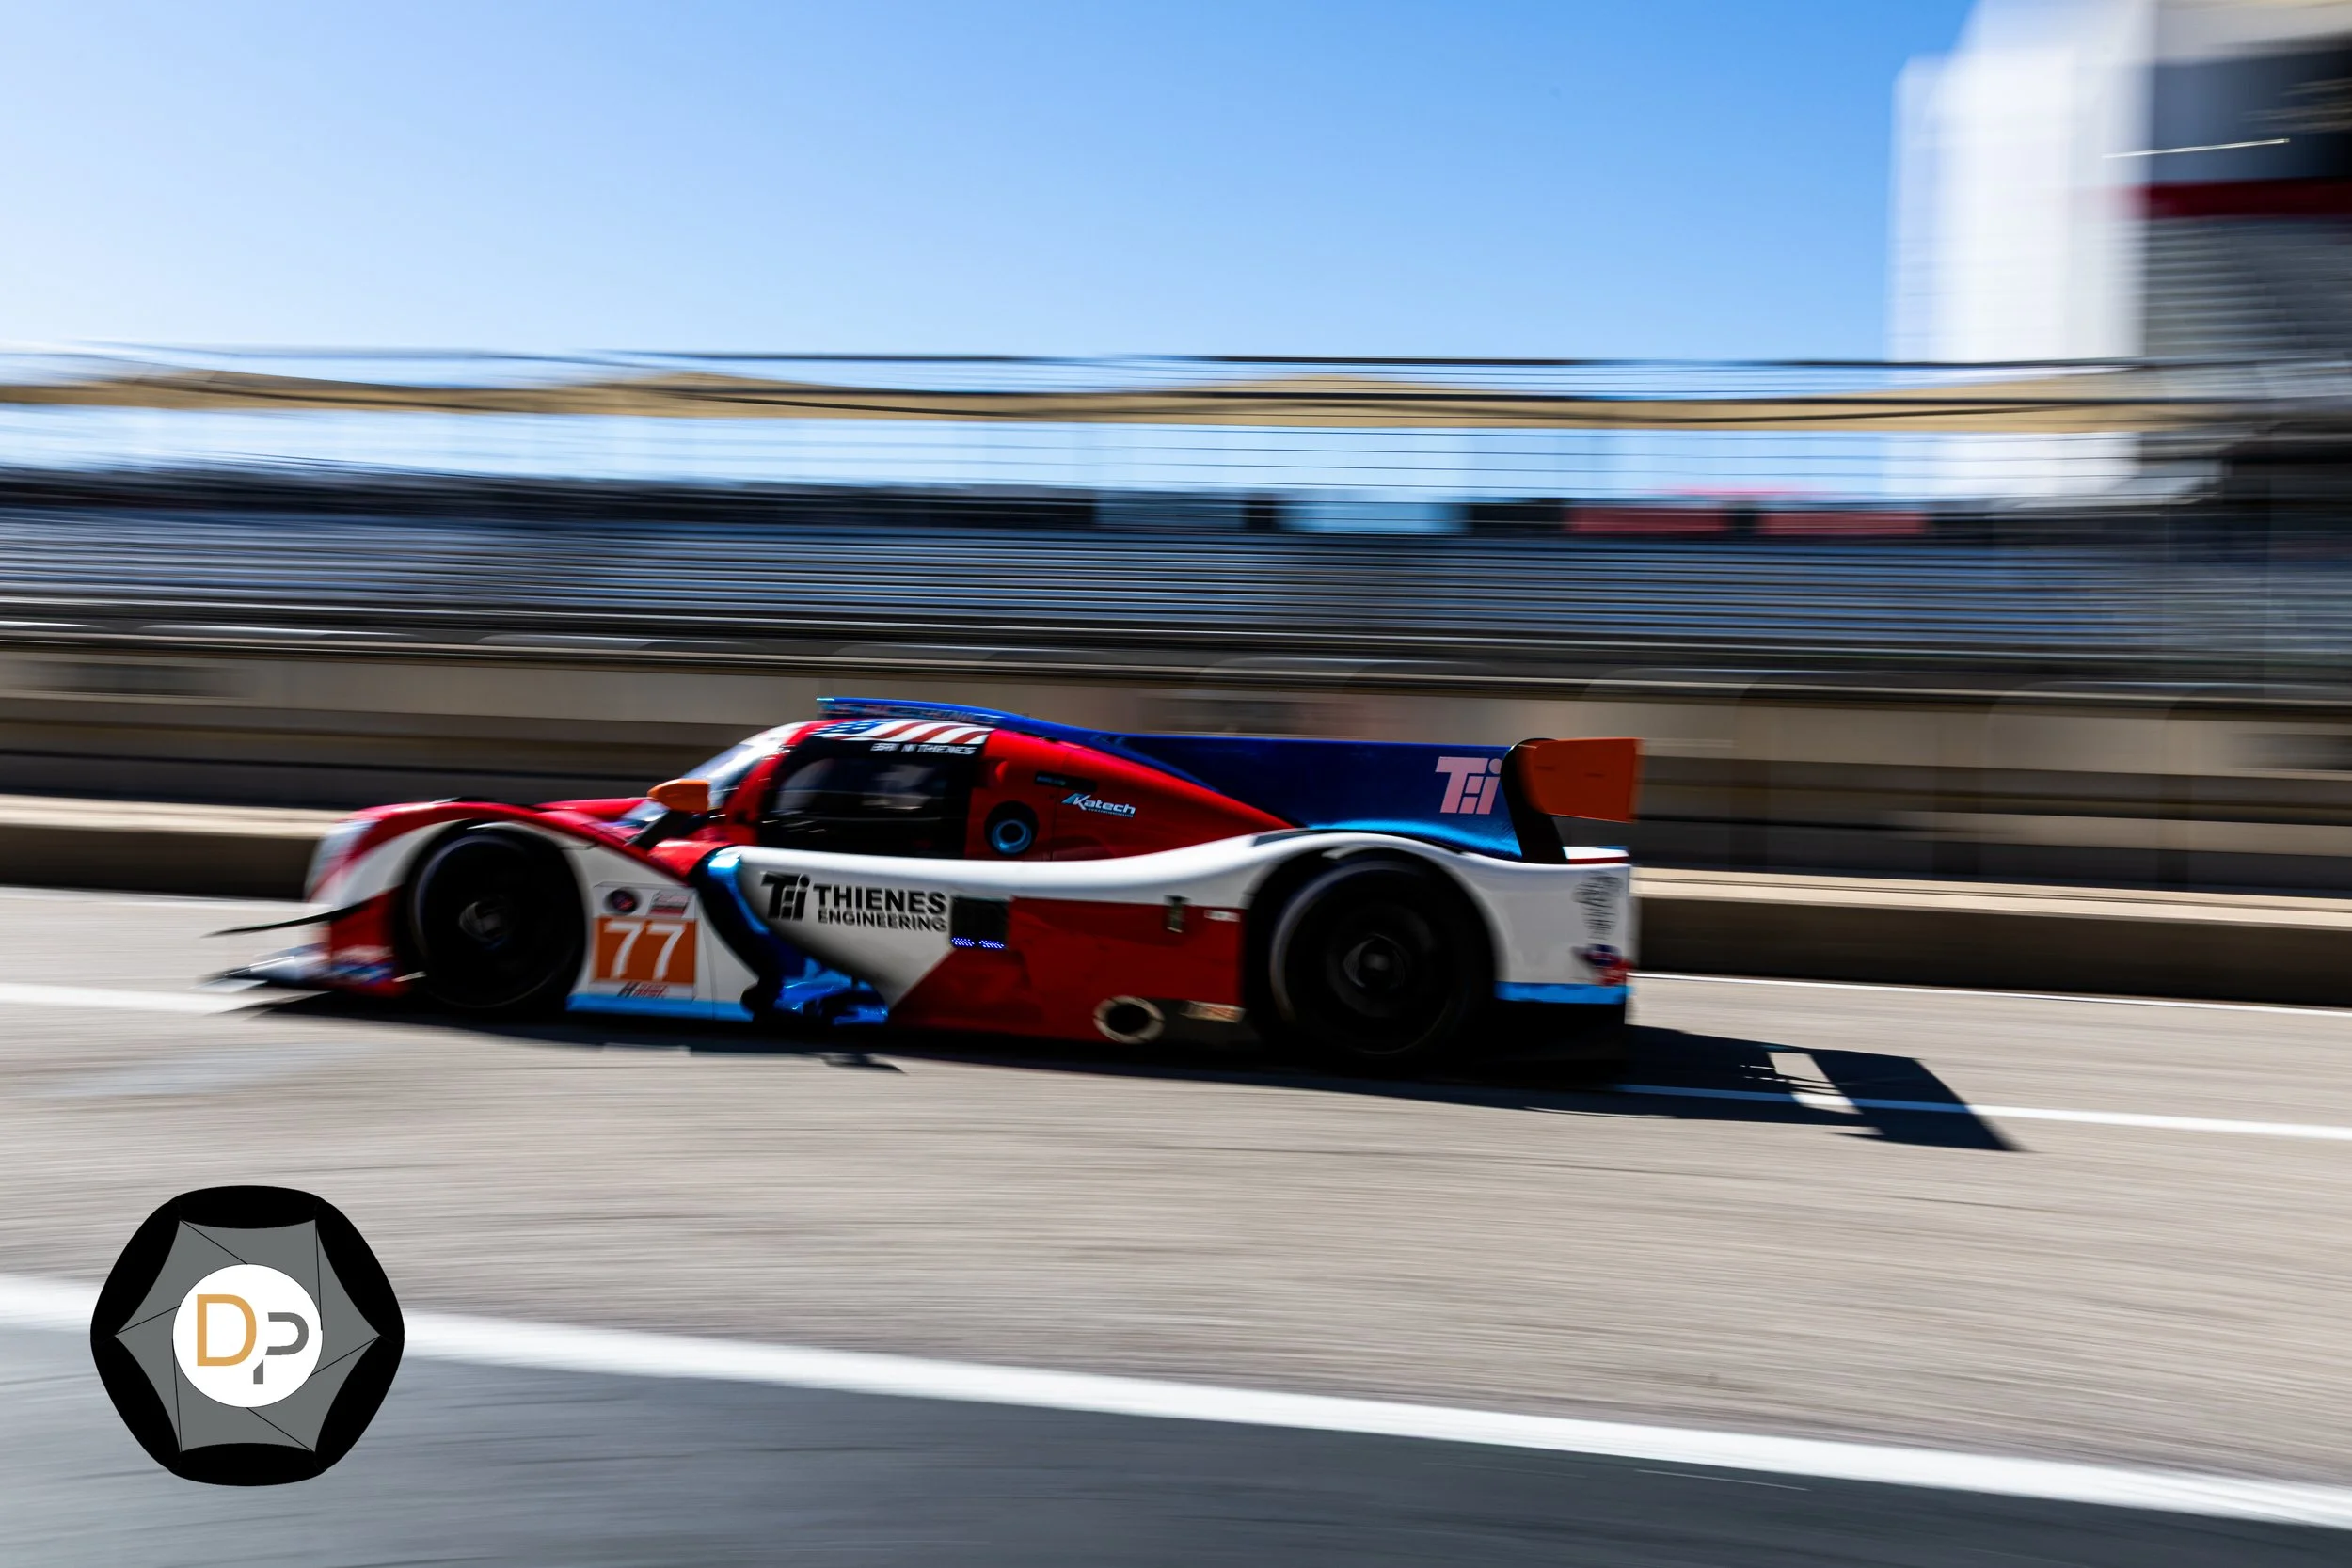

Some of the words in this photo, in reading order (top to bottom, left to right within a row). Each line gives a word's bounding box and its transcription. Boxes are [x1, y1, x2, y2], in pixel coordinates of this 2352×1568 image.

[916, 744, 977, 755] THIENES
[1071, 794, 1136, 816] Katech
[813, 883, 946, 915] THIENES
[817, 908, 947, 933] ENGINEERING
[604, 920, 687, 981] 77
